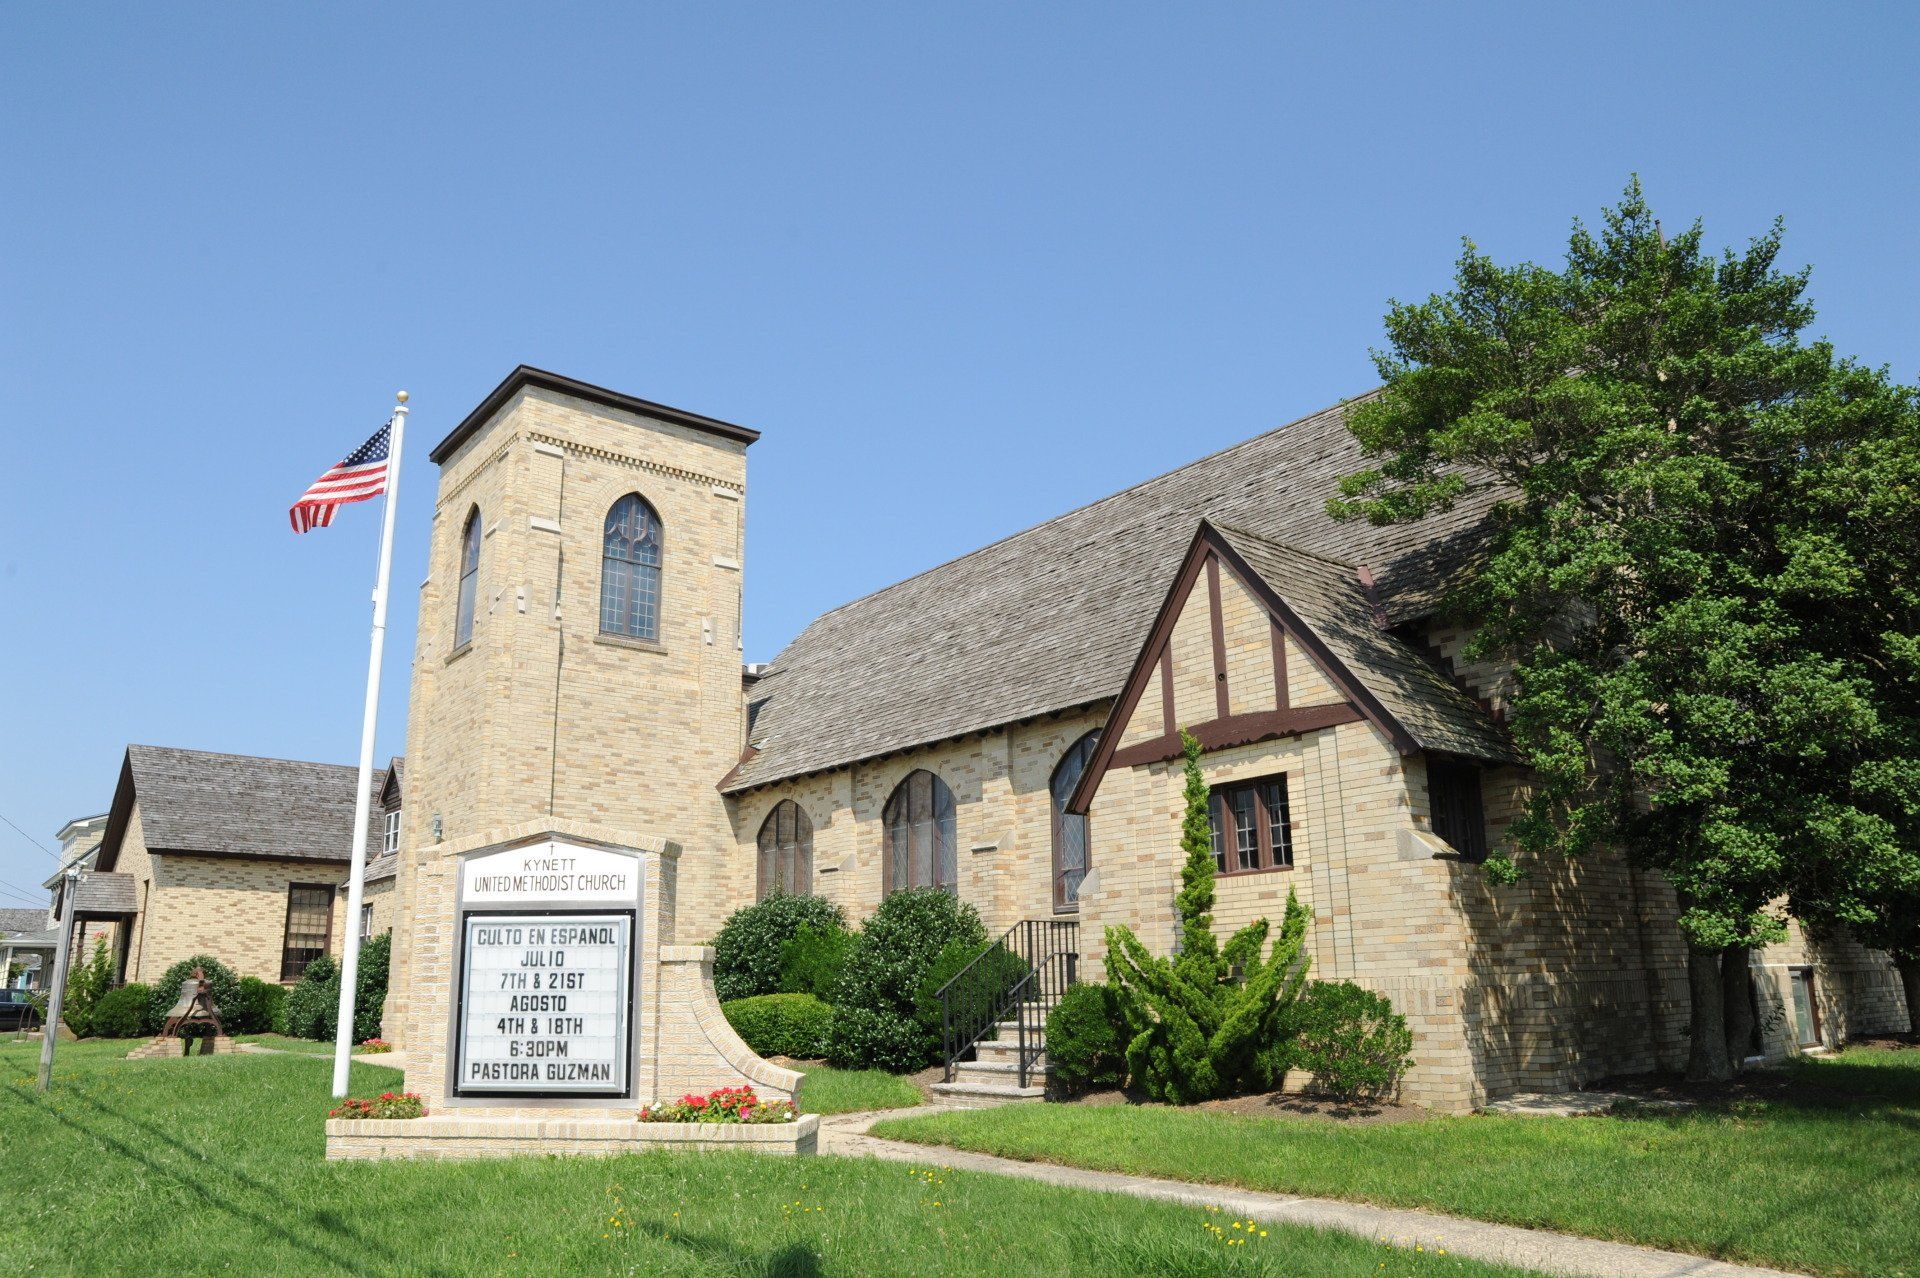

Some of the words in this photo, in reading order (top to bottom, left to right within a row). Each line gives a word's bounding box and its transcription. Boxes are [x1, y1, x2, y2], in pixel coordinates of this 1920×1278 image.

[524, 858, 576, 872] KYNETT
[475, 876, 511, 893] UNITED
[513, 875, 575, 892] METHODIST
[578, 874, 626, 891] CHURCH
[478, 928, 522, 946] CULTO
[529, 928, 545, 945] EN
[551, 927, 615, 945] ESPANOL
[521, 951, 564, 967] JULIO
[501, 973, 527, 989] 7TH
[533, 973, 541, 989] &
[549, 972, 585, 989] 21ST
[510, 995, 567, 1012] AGOSTO
[497, 1018, 524, 1035] 4TH
[531, 1018, 538, 1034] &
[549, 1017, 583, 1034] 18TH
[510, 1040, 568, 1058] 6:30PM
[472, 1063, 539, 1080] PASTORA
[547, 1063, 610, 1081] GUZMAN
